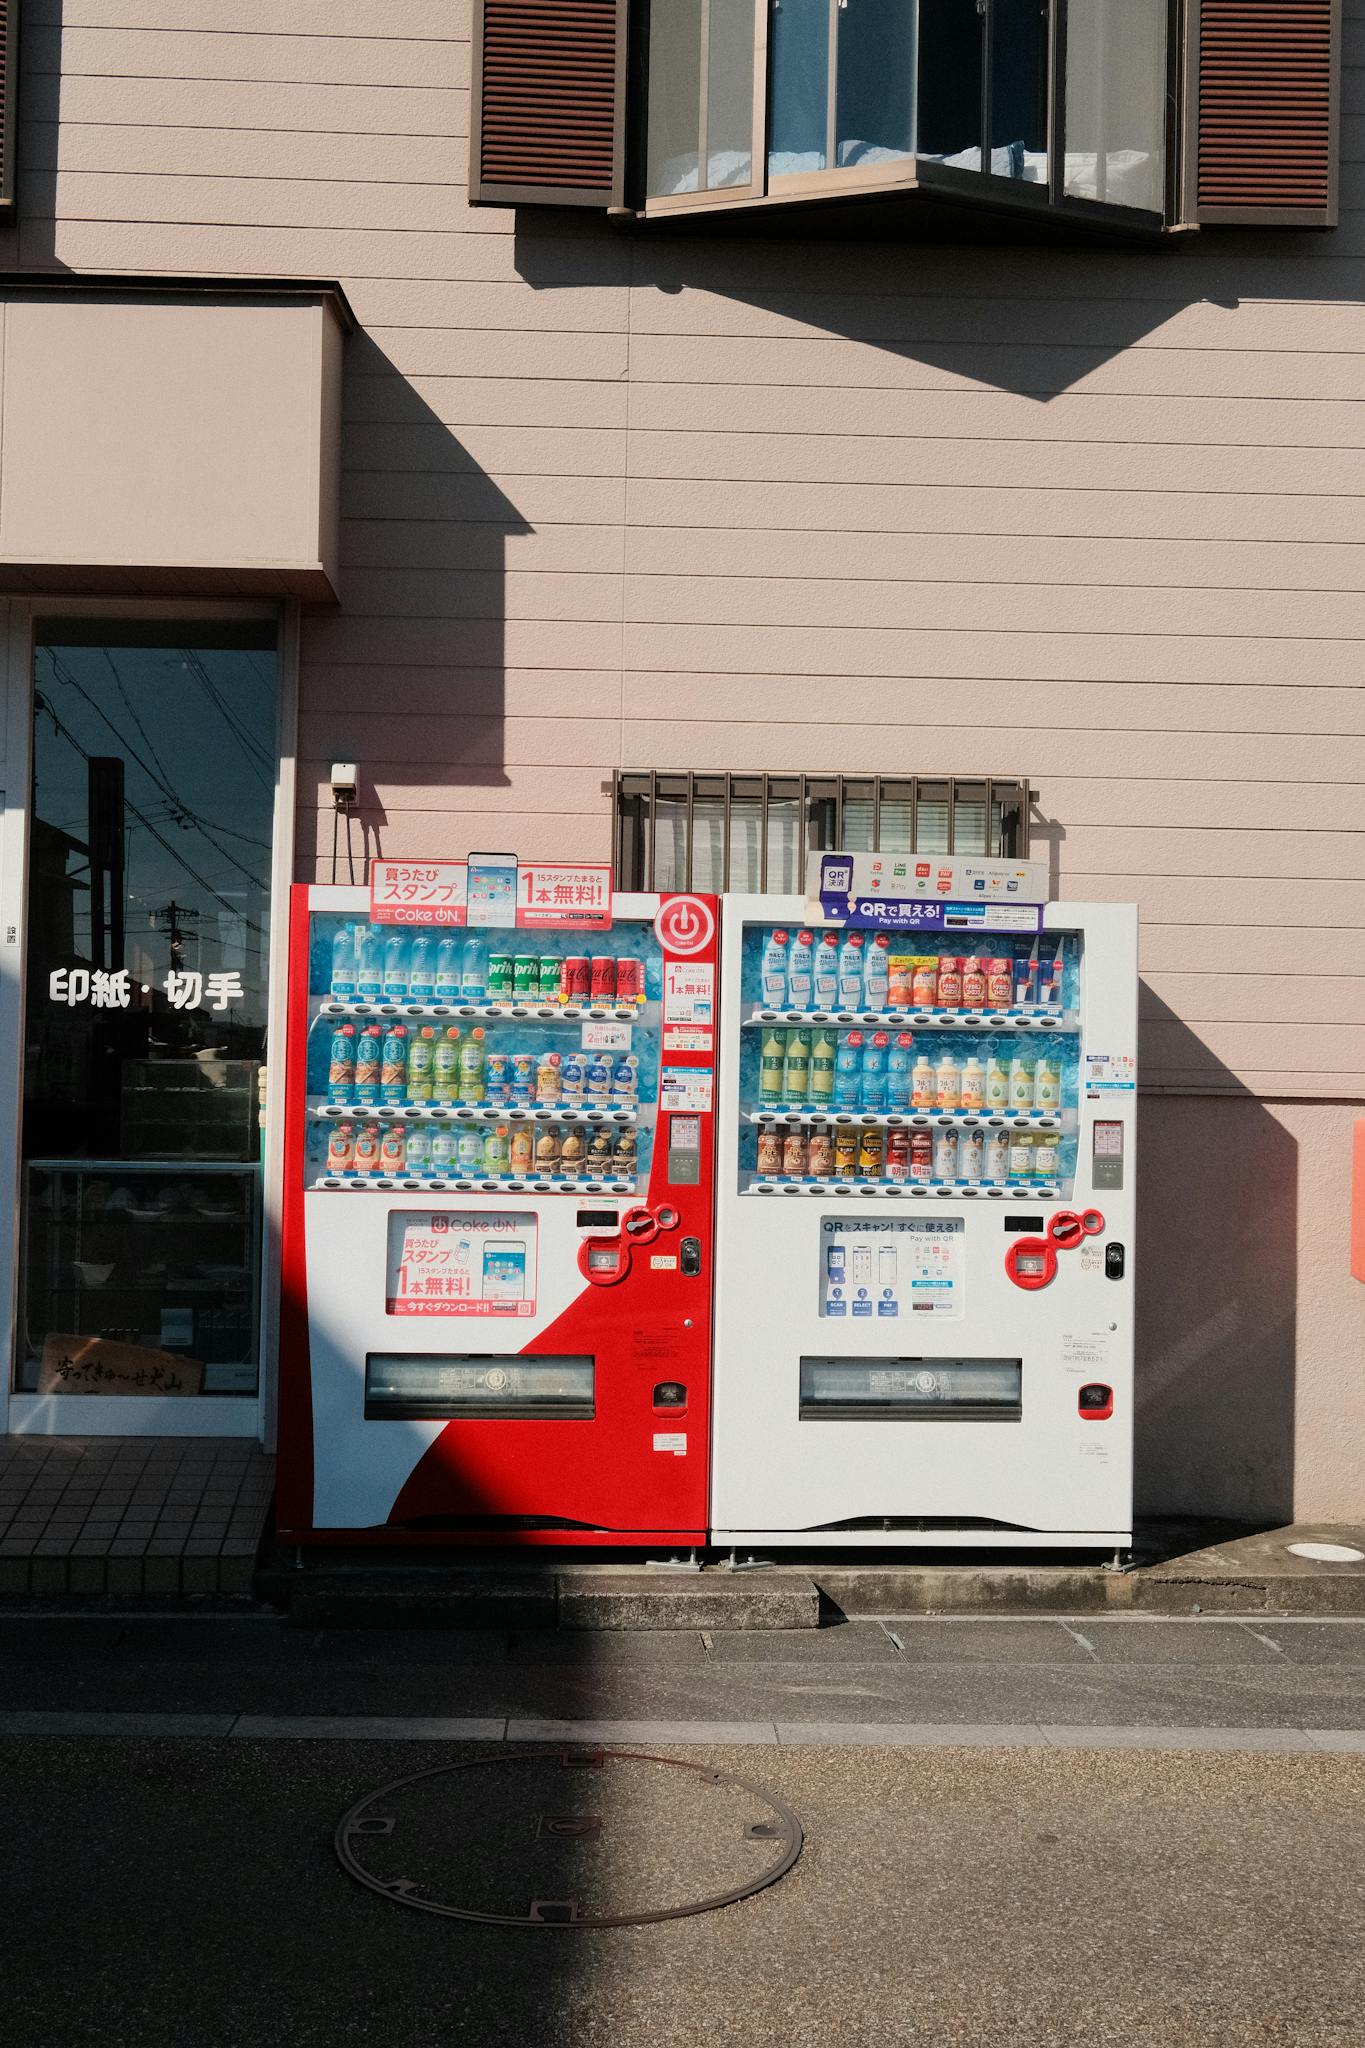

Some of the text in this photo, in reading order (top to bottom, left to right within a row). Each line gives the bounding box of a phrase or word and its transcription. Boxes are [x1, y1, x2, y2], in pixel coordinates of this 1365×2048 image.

[385, 867, 439, 882] 買うたび
[537, 873, 603, 884] 15スタンプたまると
[828, 871, 845, 880] QR
[521, 872, 602, 906] 1本無料!
[828, 879, 844, 888] 決済
[384, 882, 458, 901] スタンプ
[395, 908, 433, 922] Coke
[860, 902, 940, 918] QRで買える!
[879, 917, 892, 925] Pay
[49, 967, 244, 1011] 印紙・切手
[450, 1219, 490, 1232] Coke
[824, 1222, 958, 1233] QRをスキャン! すぐに使える!
[405, 1239, 438, 1248] 買うたび
[403, 1248, 453, 1263] スタンプ
[396, 1265, 470, 1296] 1本無料!
[407, 1302, 489, 1313] 今すぐダウンロード!!
